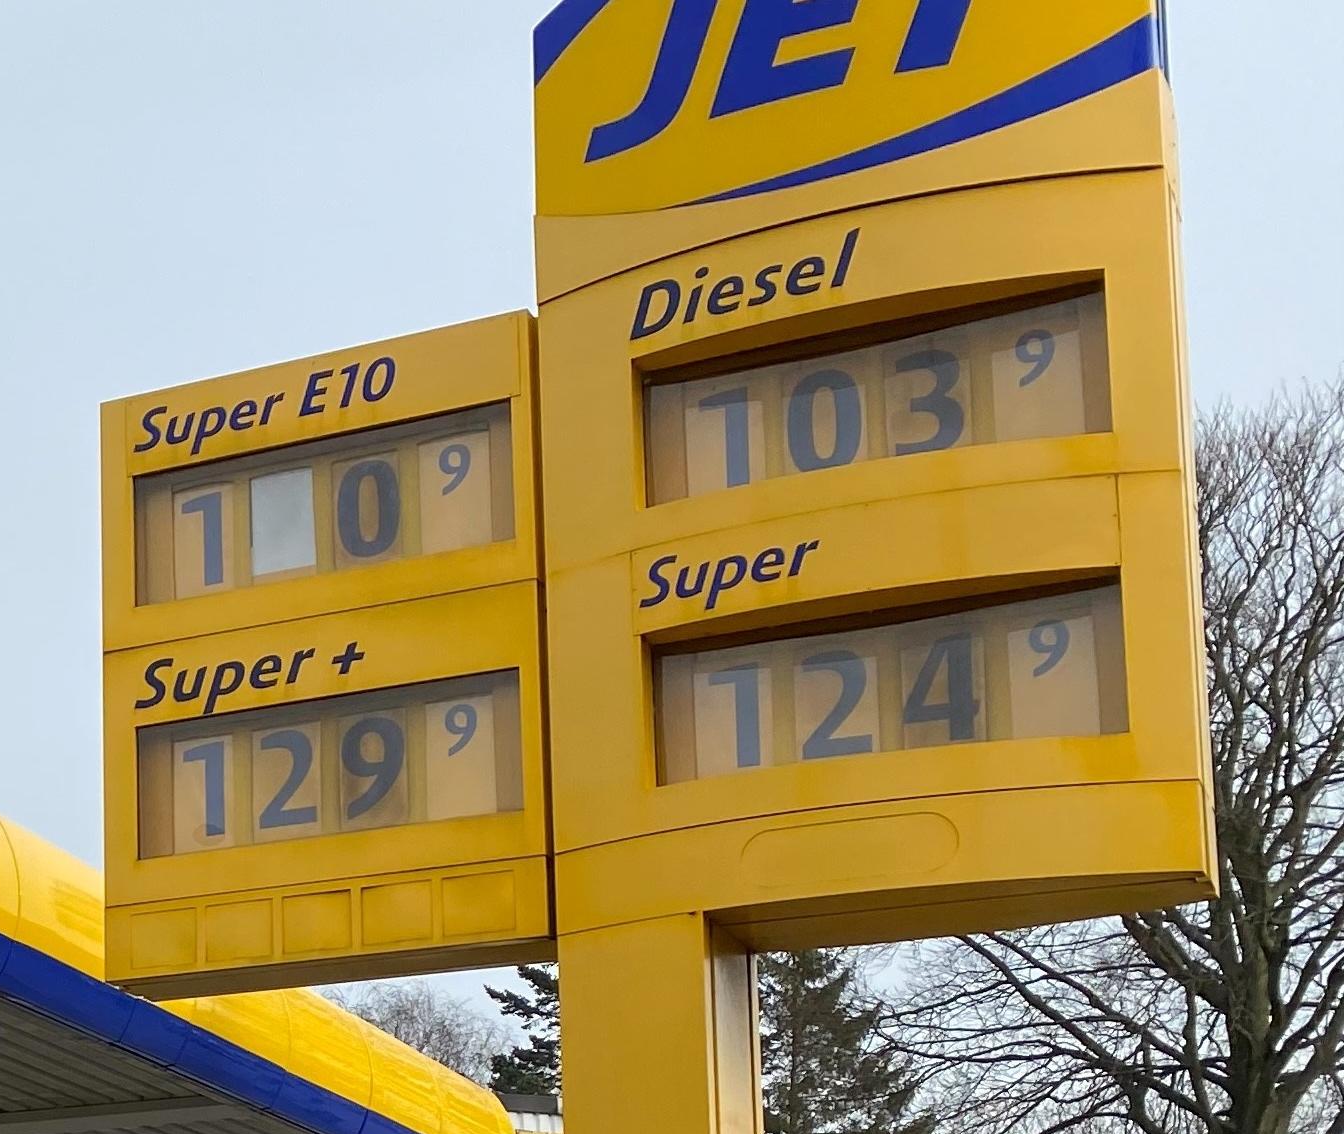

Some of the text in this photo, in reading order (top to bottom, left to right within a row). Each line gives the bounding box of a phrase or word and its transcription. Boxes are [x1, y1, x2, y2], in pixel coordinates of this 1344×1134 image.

[630, 227, 860, 341] Diesel
[133, 356, 396, 455] Super E10
[639, 539, 820, 611] Super
[134, 647, 315, 714] Super
